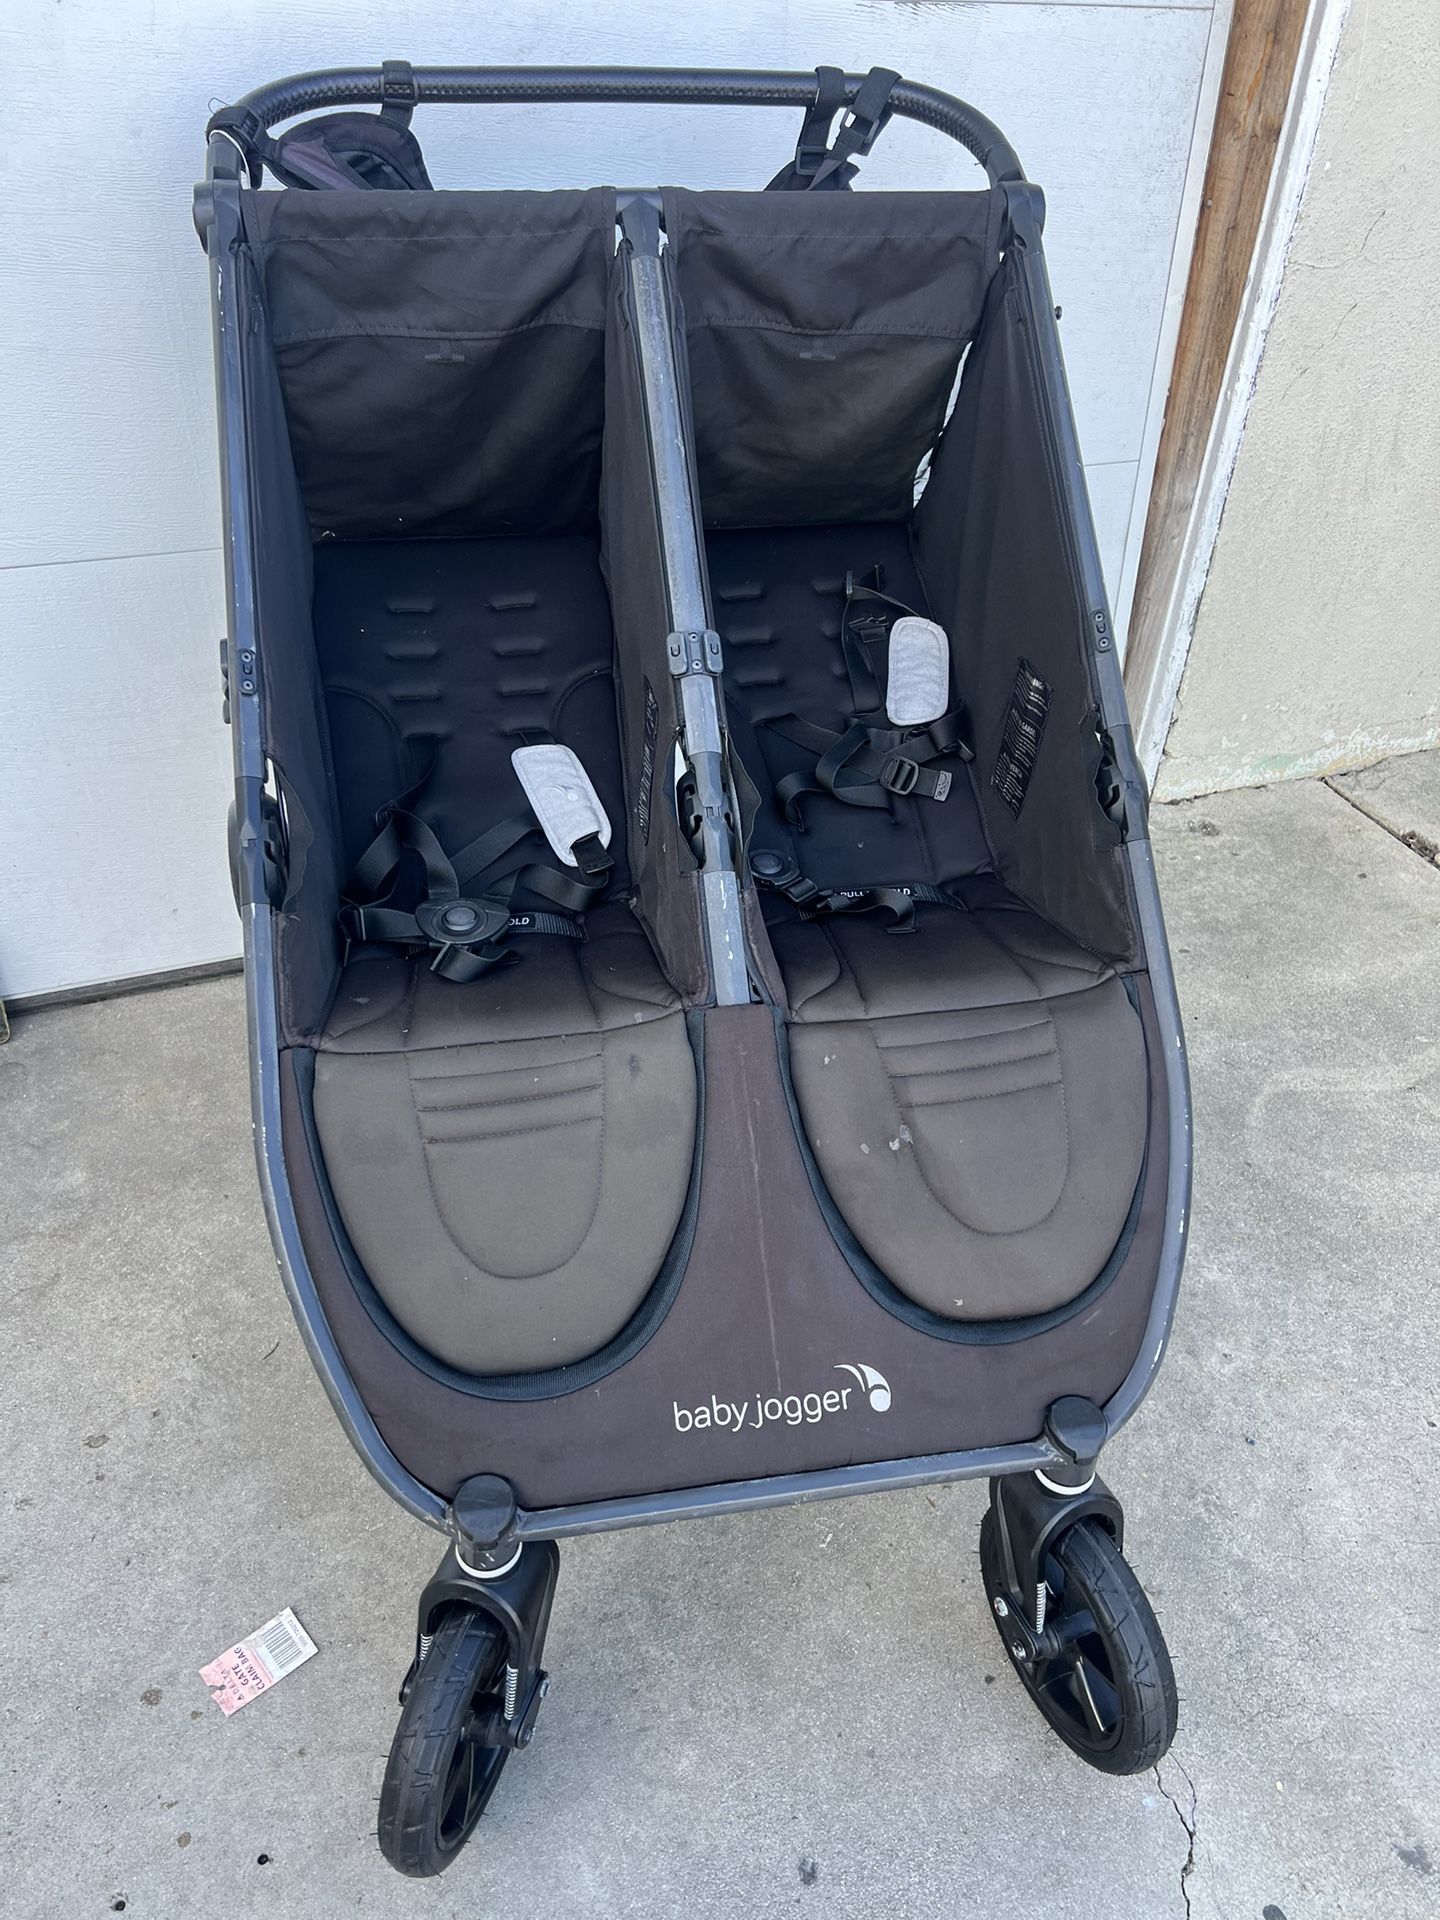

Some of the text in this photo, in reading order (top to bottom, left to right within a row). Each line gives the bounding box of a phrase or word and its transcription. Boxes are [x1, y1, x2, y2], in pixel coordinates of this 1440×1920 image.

[508, 917, 530, 926] OLD
[673, 1387, 852, 1432] baby jogger
[233, 1646, 250, 1665] BAG
[221, 1668, 240, 1695] DELTA
[231, 1663, 250, 1686] GATE
[245, 1663, 266, 1690] CLAIM
